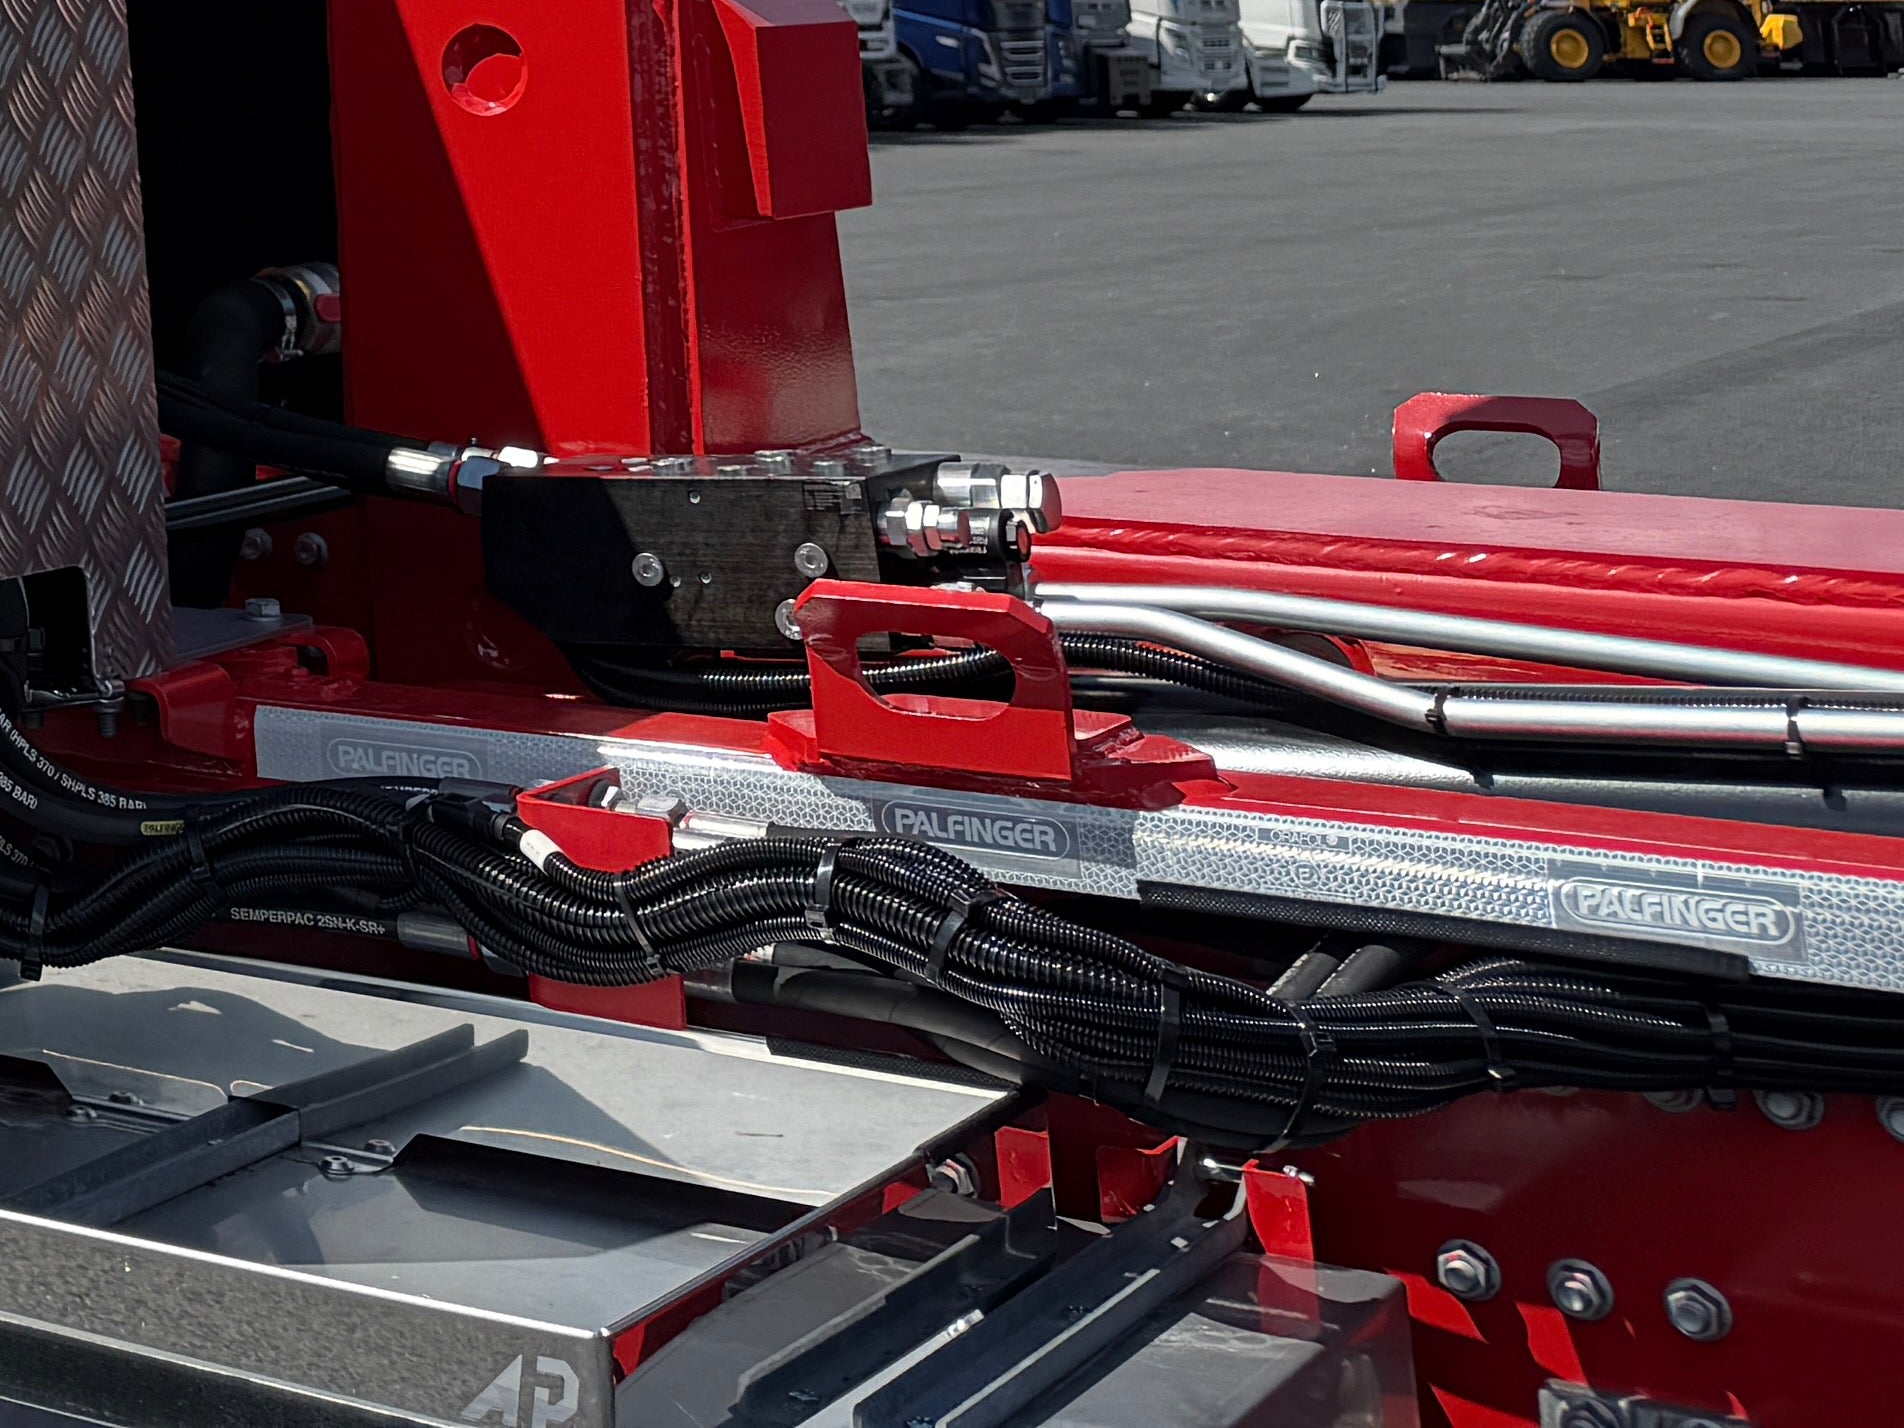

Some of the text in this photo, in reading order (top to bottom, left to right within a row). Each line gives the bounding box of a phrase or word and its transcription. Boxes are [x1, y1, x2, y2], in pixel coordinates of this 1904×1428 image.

[36, 756, 55, 778] 370
[337, 744, 474, 778] PALFINGER
[894, 807, 1057, 852] PALFINGER
[230, 907, 315, 927] SEMPERPAC
[1578, 883, 1779, 937] PALFINGER
